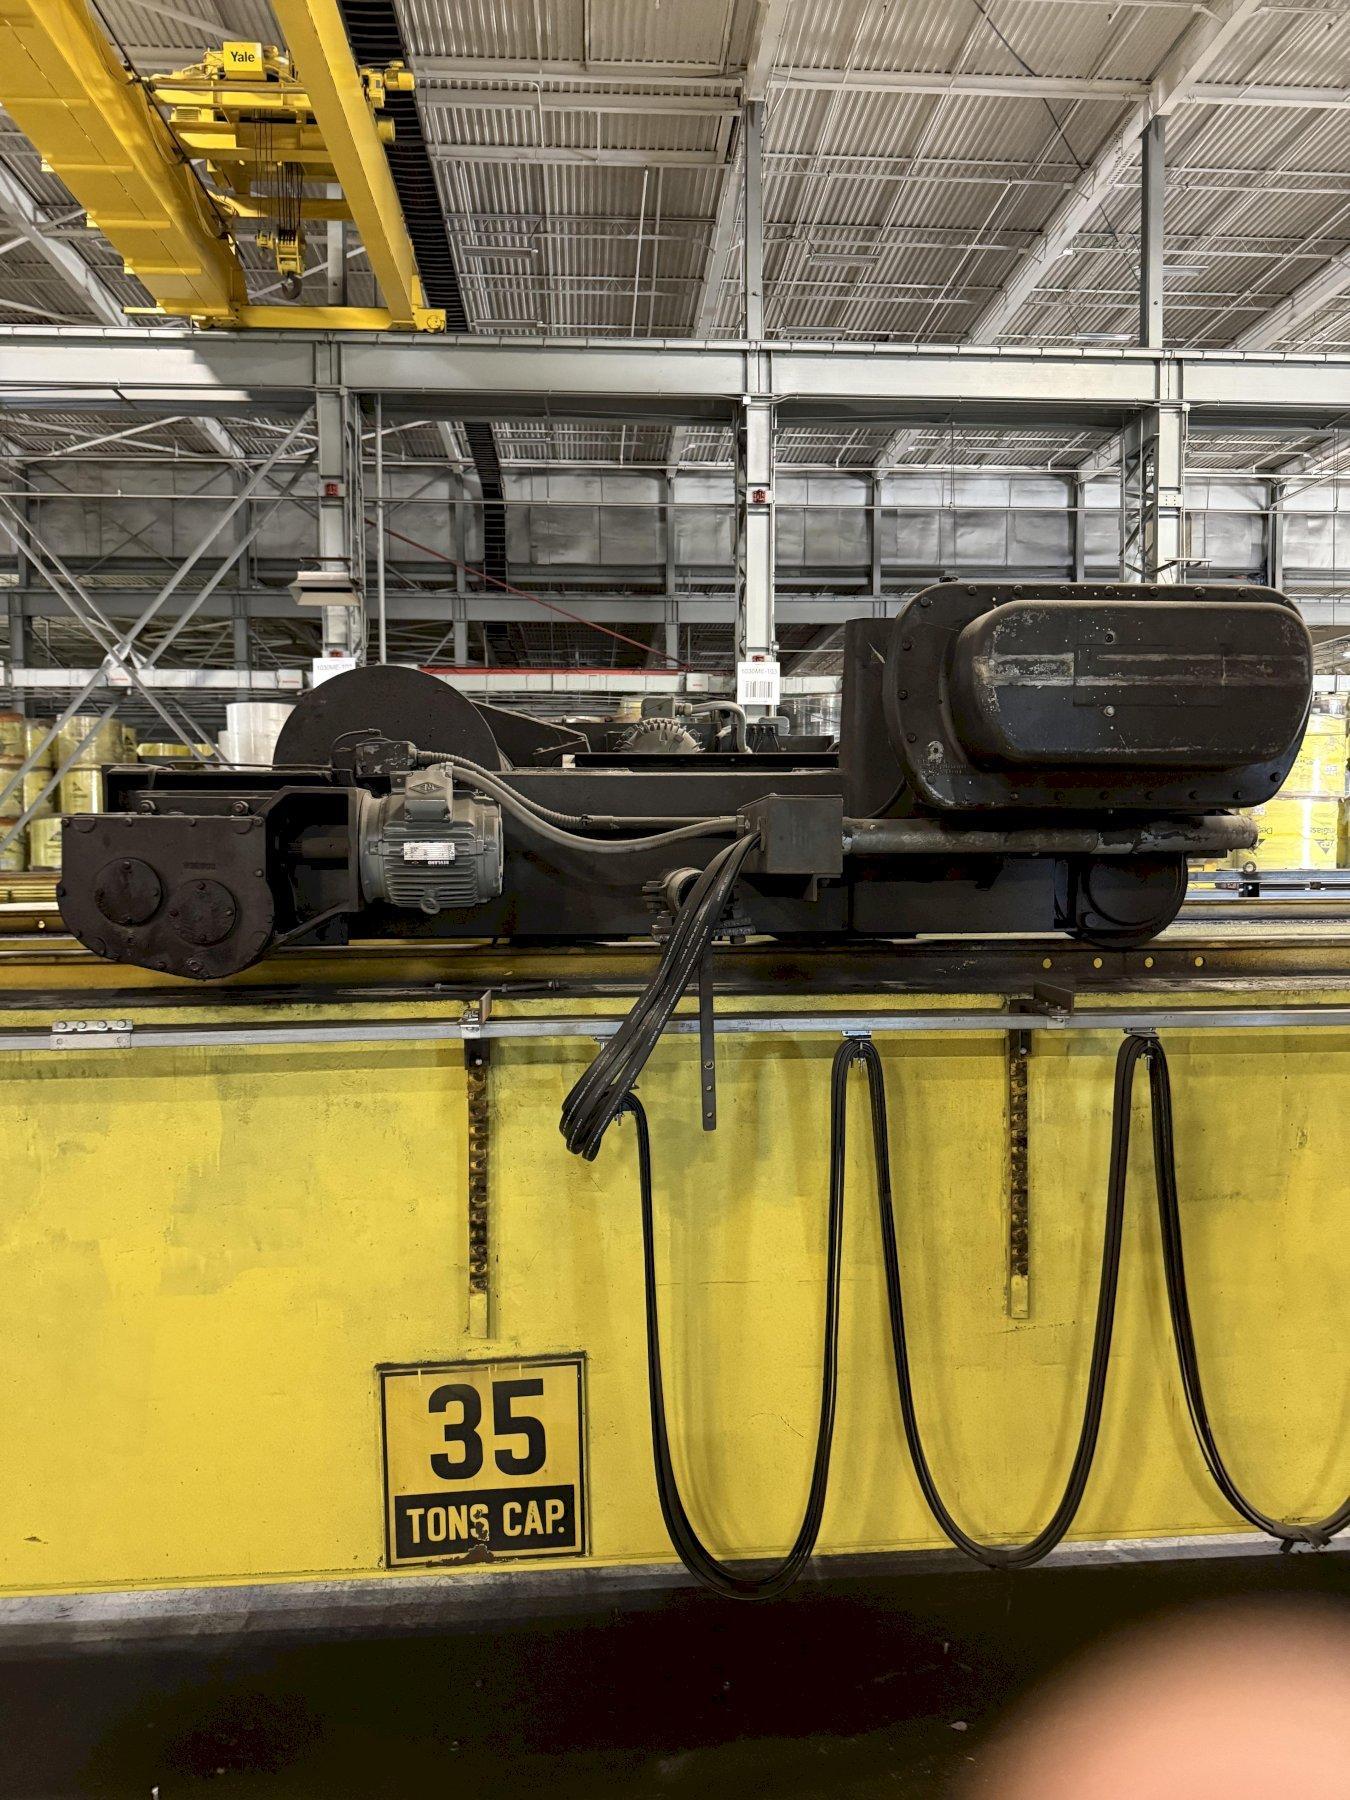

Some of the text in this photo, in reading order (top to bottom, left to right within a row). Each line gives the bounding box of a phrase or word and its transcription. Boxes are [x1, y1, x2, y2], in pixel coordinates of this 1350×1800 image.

[230, 51, 255, 62] Yale
[428, 1378, 547, 1480] 35
[406, 1498, 565, 1544] TONS CAP.
